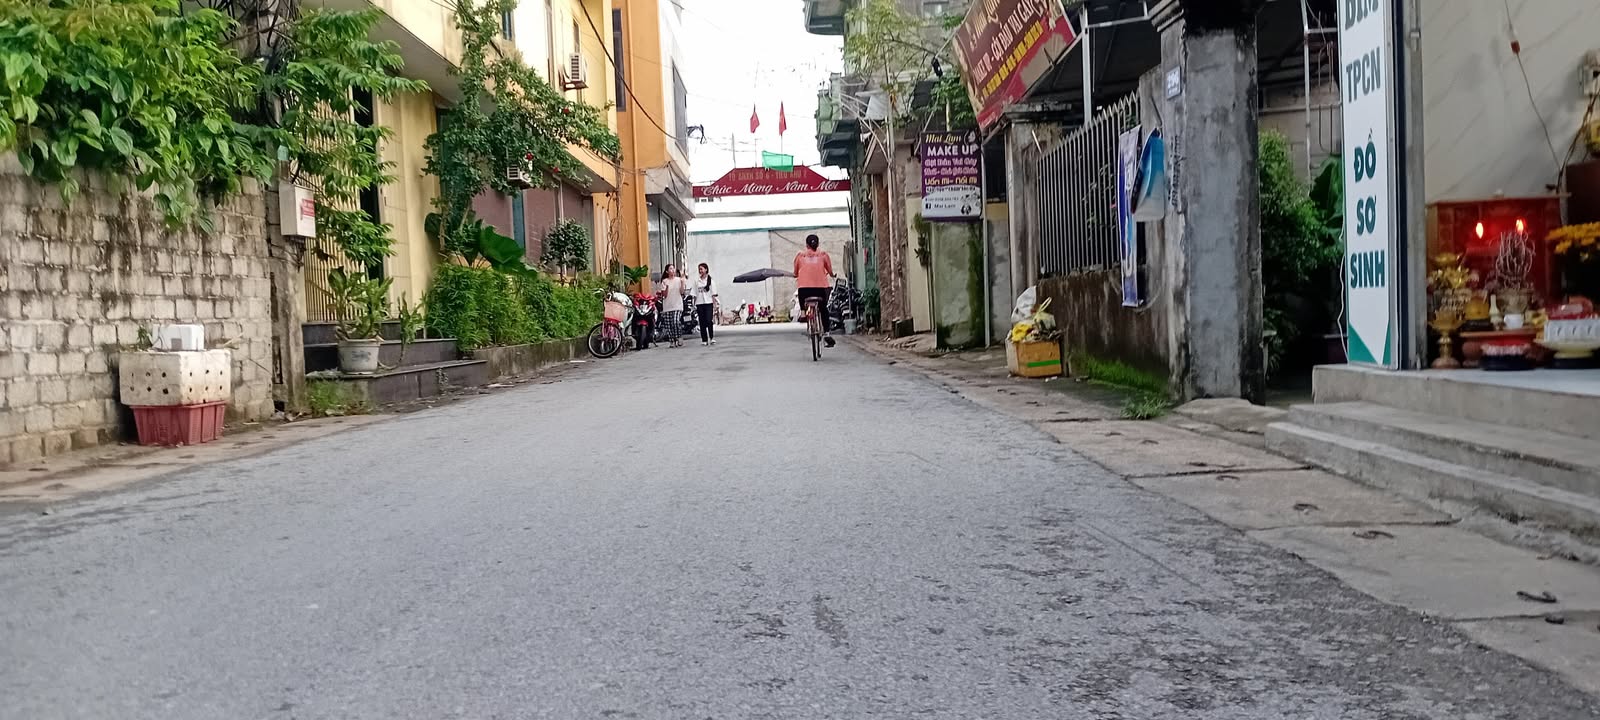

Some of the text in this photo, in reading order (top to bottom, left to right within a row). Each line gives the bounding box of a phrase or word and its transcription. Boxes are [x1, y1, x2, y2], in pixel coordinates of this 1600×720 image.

[1346, 46, 1381, 103] TPCN
[927, 144, 978, 157] MAKE UP
[701, 184, 732, 196] Chúc
[1357, 195, 1377, 236] SƠ
[1351, 250, 1385, 289] SINH
